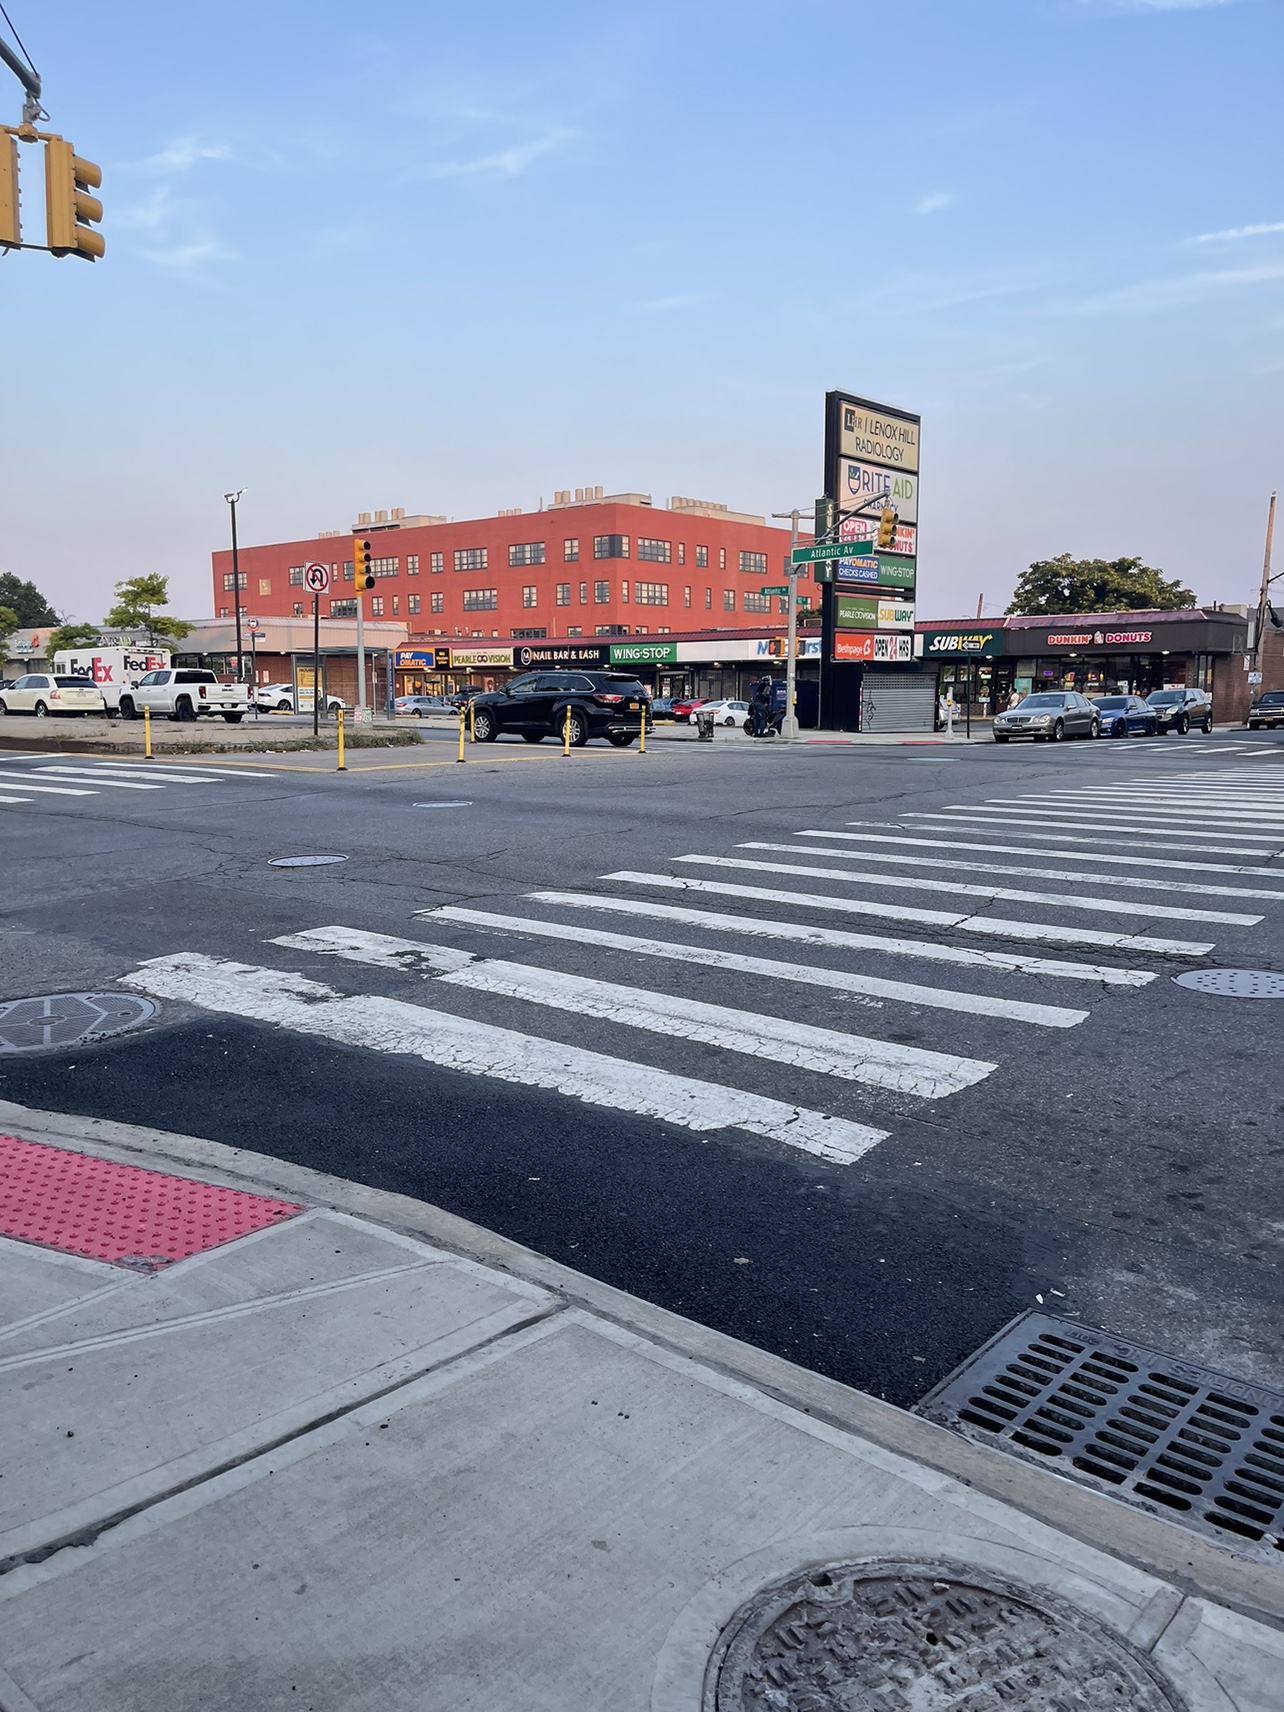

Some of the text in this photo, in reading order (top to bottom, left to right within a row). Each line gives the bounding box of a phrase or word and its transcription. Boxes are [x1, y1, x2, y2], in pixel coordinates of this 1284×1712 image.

[870, 419, 897, 442] LENOX
[898, 428, 916, 446] HILL
[855, 437, 904, 462] RADIOLOGY
[863, 470, 913, 500] RITE AID
[844, 520, 866, 533] OPEN
[811, 546, 854, 559] Atlantic Av
[839, 568, 878, 580] CHECKS CASHED
[840, 610, 876, 621] PEARLE VISION
[879, 608, 914, 622] SUBWAY
[1105, 632, 1152, 644] DONUTS
[837, 643, 863, 656] Bethpage
[875, 636, 910, 660] OPEN 24 HRS
[401, 652, 413, 660] PAY
[454, 654, 476, 664] PEARLE
[488, 653, 511, 664] VISION
[533, 651, 553, 661] NAIL
[553, 651, 569, 661] BAR
[570, 650, 577, 660] &
[579, 650, 599, 660] LASH
[124, 655, 167, 671] FedEx
